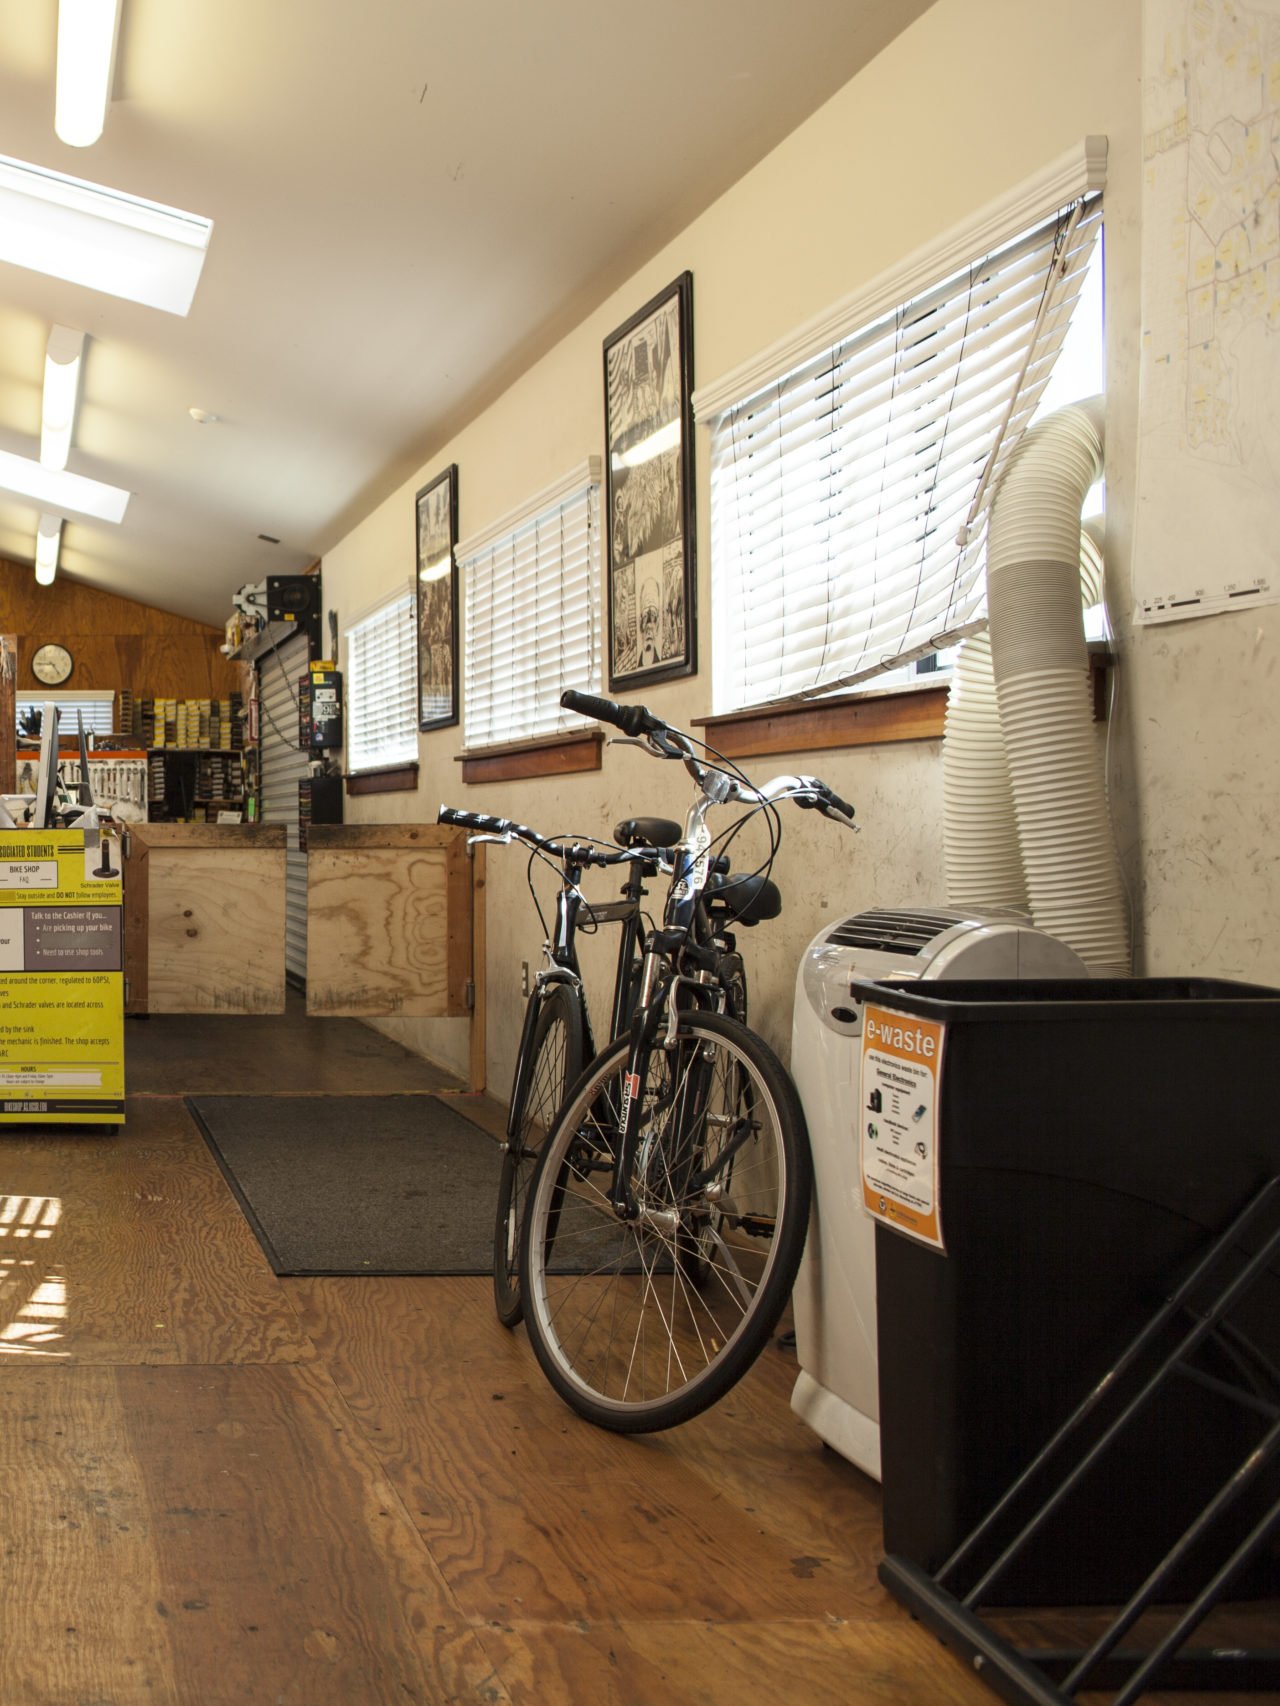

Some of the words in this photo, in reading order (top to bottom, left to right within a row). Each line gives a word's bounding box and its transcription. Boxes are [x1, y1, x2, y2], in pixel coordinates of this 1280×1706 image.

[26, 845, 54, 858] STUDENTS
[24, 865, 40, 873] SHOP
[17, 892, 27, 900] Stay
[31, 912, 44, 920] Talk
[63, 911, 85, 919] Cashier
[86, 911, 91, 920] if
[43, 924, 52, 932] Are
[53, 924, 75, 934] picking
[43, 949, 56, 957] Need
[76, 949, 89, 957] shop
[9, 977, 27, 985] around
[59, 977, 84, 986] regulated
[13, 1001, 37, 1009] Schrader
[38, 1001, 55, 1009] valves
[5, 1026, 11, 1034] by
[23, 1025, 35, 1033] sink
[65, 1037, 75, 1045] The
[76, 1037, 89, 1046] shop
[90, 1037, 110, 1046] accepts
[866, 1018, 936, 1058] e-waste
